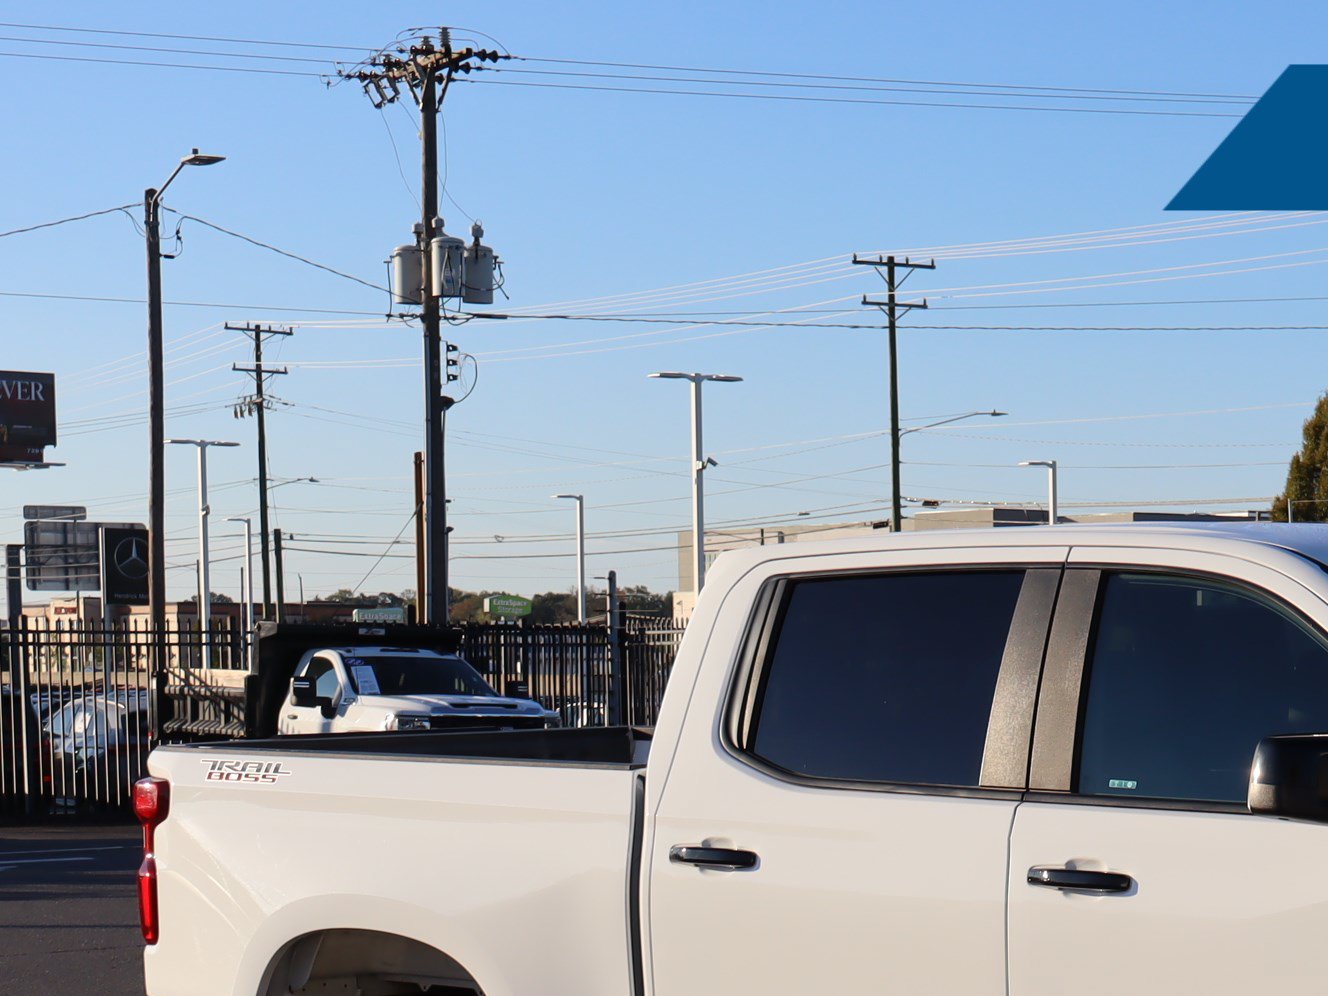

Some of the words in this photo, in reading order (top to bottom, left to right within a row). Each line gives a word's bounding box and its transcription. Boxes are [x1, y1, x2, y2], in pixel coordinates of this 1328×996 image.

[0, 380, 44, 401] VER
[497, 605, 523, 615] Storage
[201, 759, 291, 775] TRAIL
[206, 771, 279, 783] BOSS
